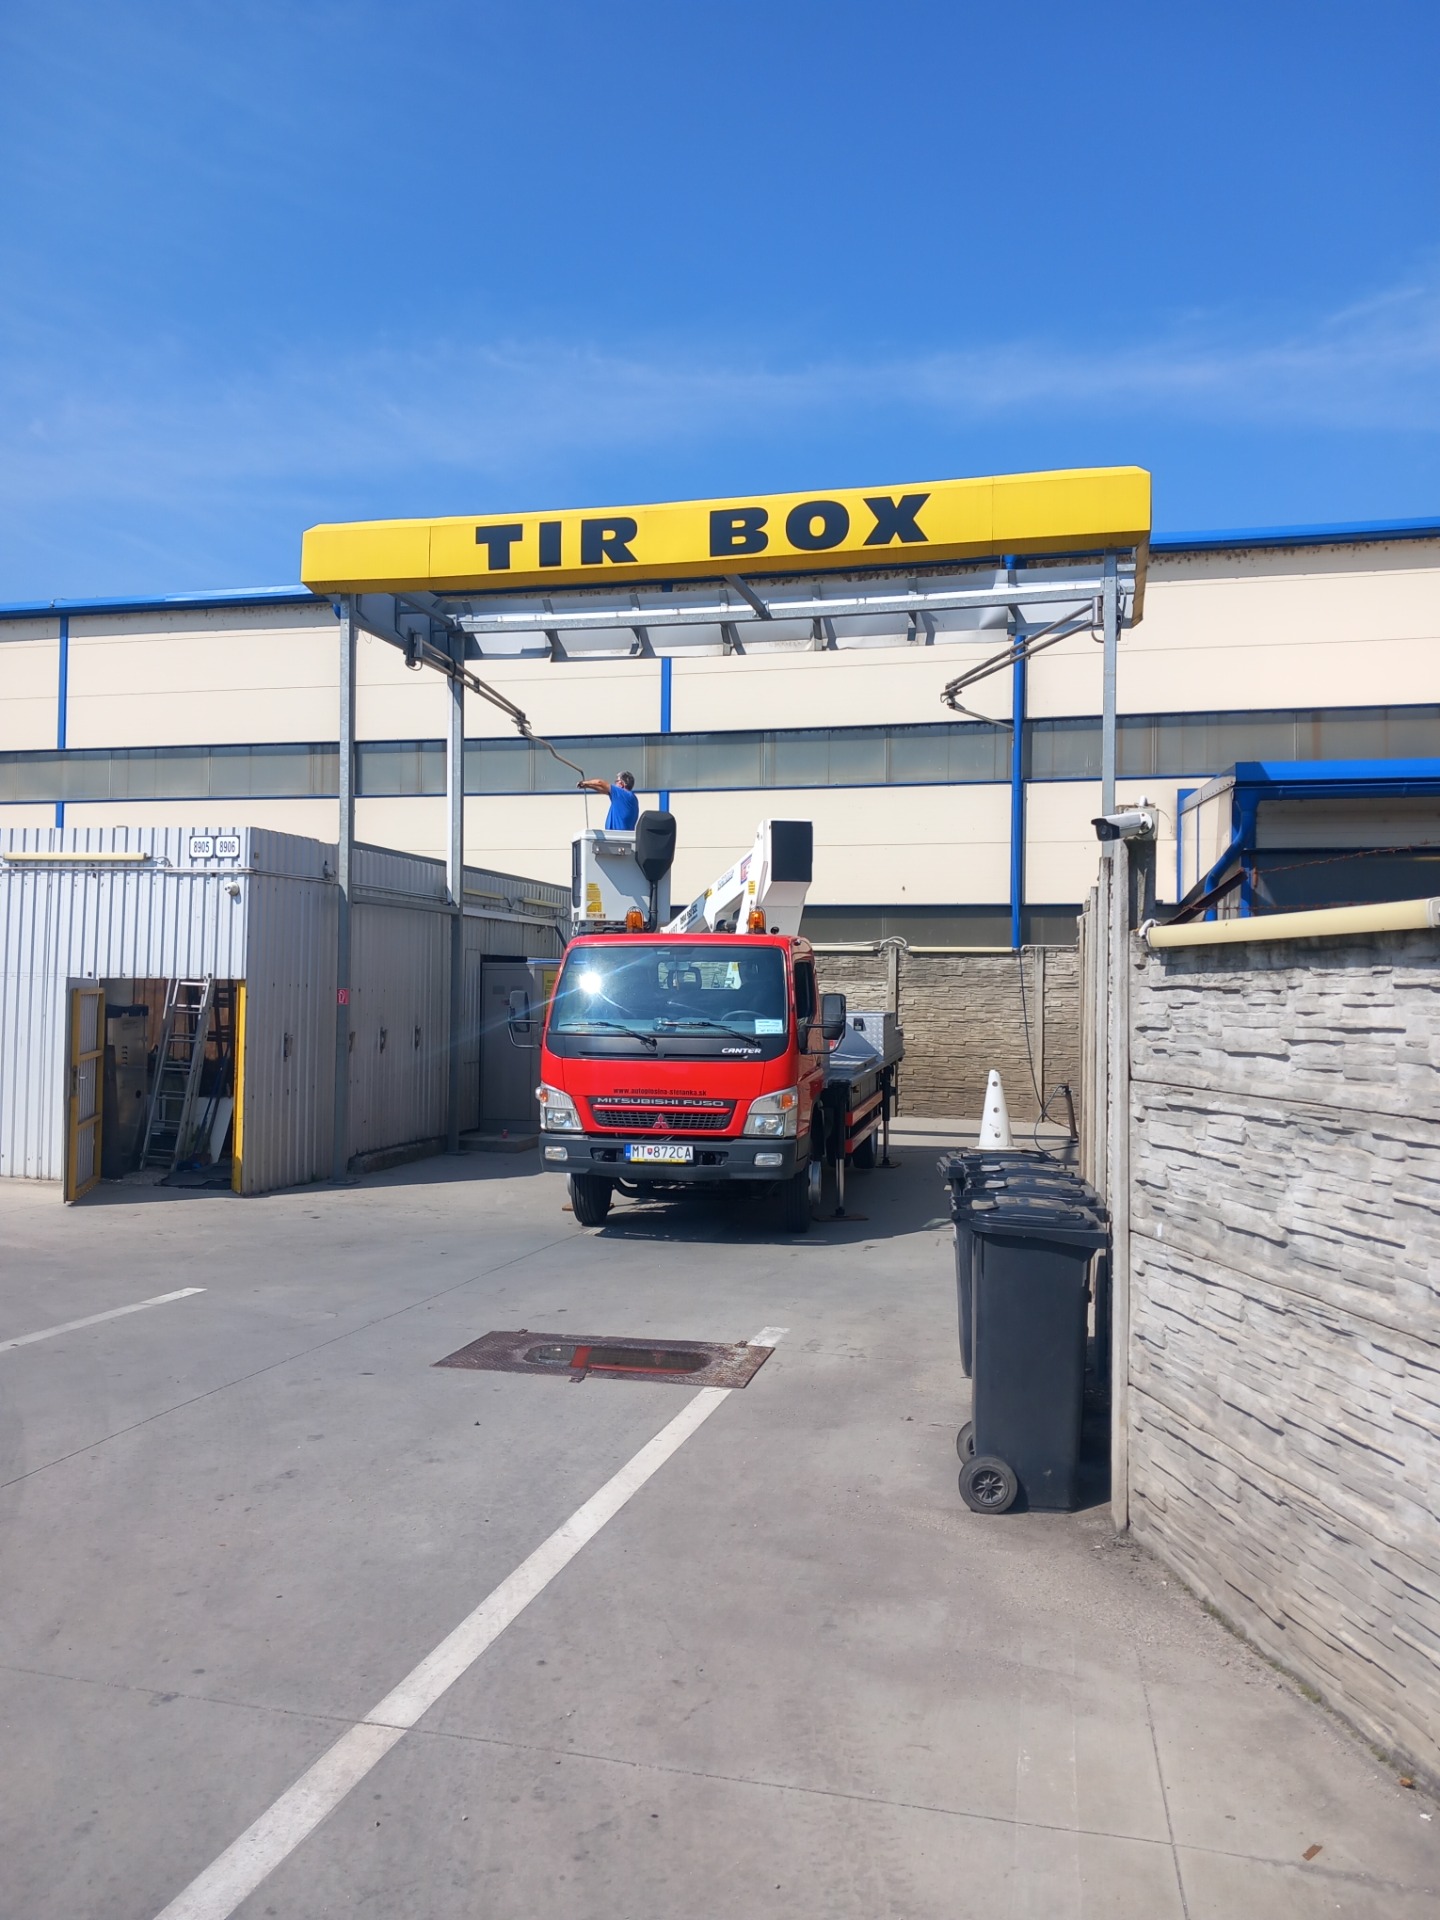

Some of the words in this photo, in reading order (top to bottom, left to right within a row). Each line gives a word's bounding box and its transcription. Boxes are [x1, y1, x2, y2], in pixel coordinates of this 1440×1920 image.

[475, 517, 638, 570] TIR
[709, 493, 931, 557] BOX
[193, 840, 210, 853] 8905
[219, 840, 236, 853] 8906
[597, 1097, 679, 1105] MITSUBISHI
[683, 1099, 724, 1107] FUSO
